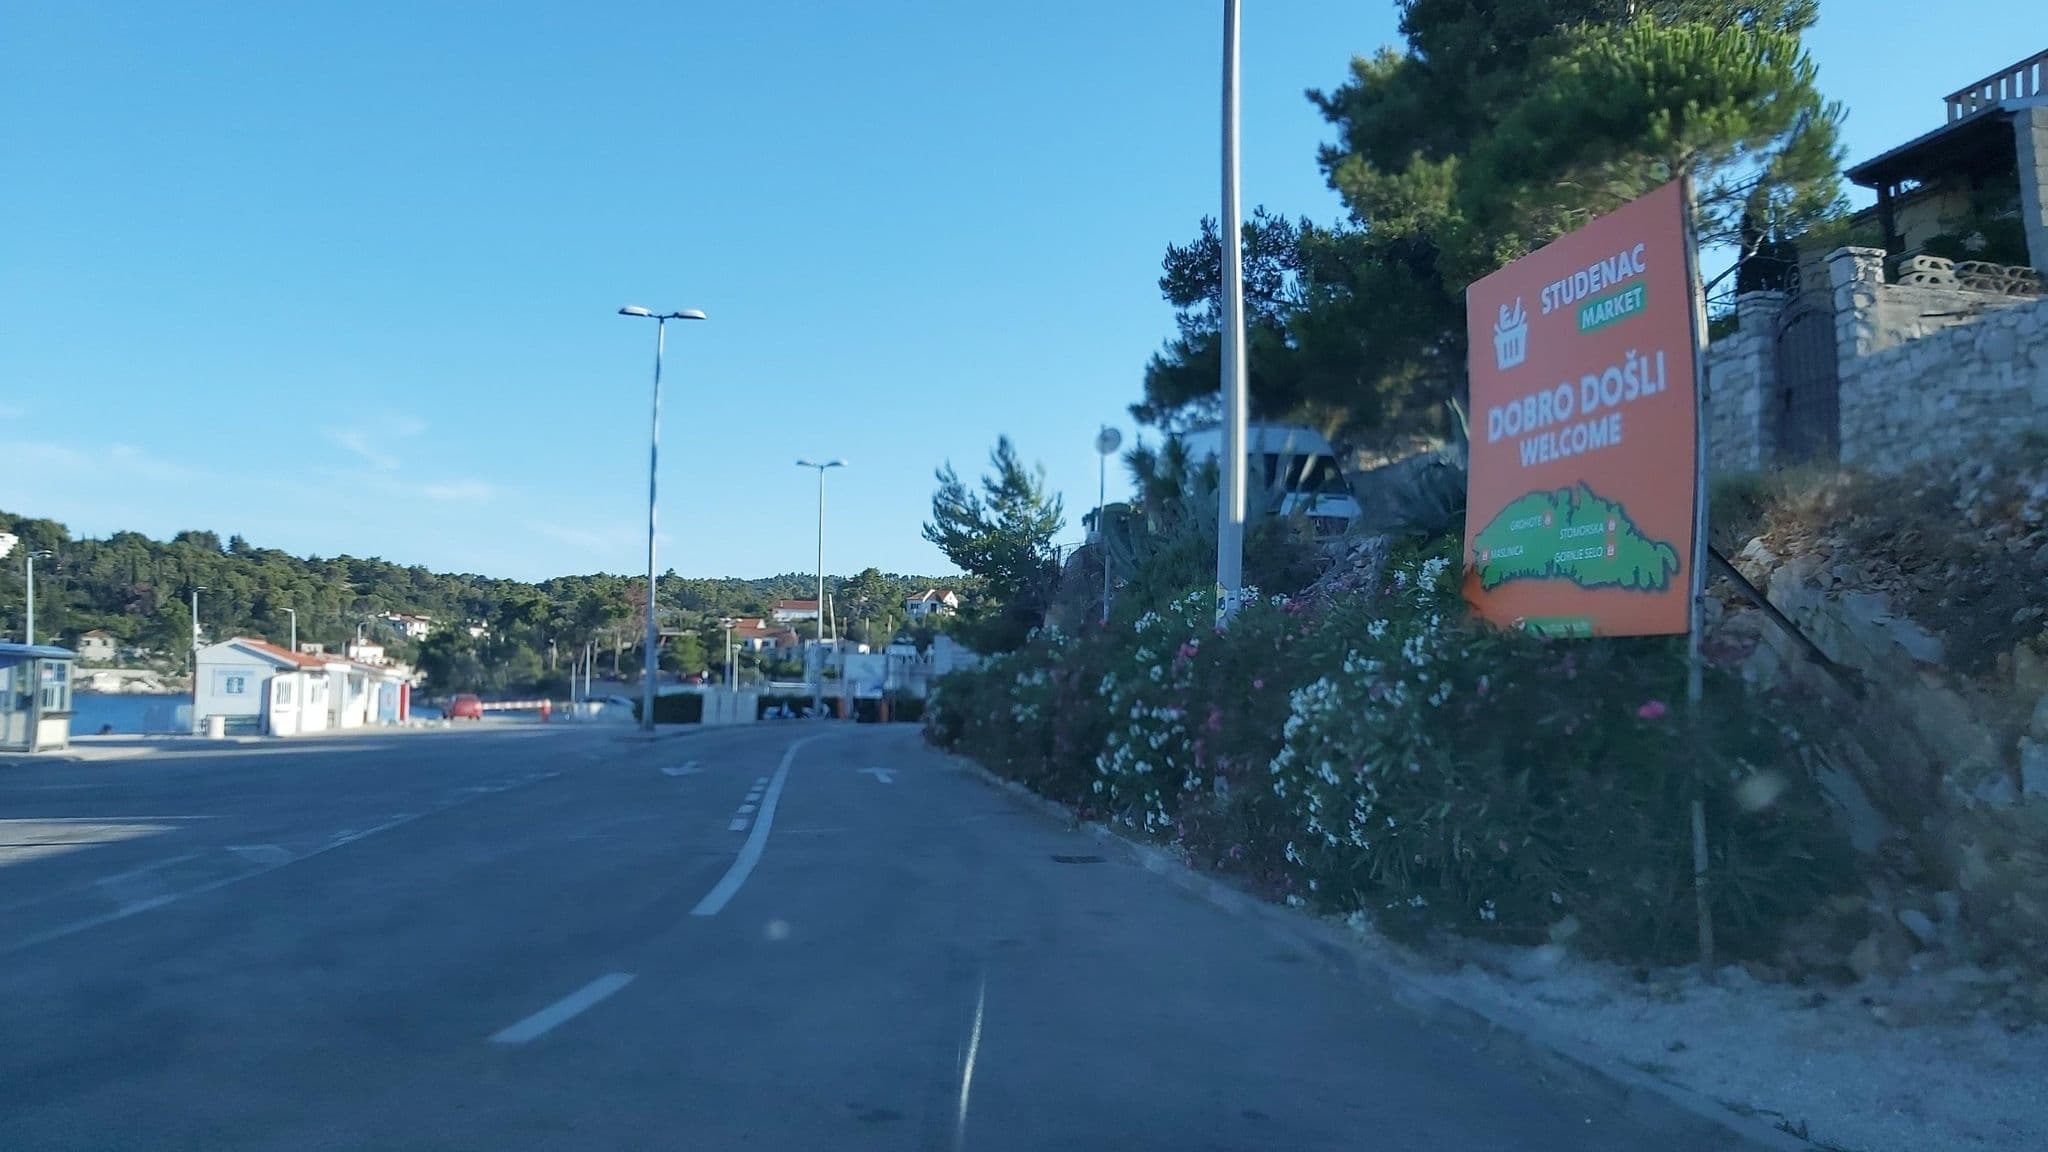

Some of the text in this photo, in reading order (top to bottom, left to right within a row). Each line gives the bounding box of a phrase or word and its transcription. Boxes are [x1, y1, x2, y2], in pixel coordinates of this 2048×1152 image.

[1540, 243, 1646, 314] STUDENAC
[1581, 287, 1642, 329] MARKET
[1488, 349, 1666, 443] DOBRO DOŠLI
[1519, 412, 1622, 467] WELCOME
